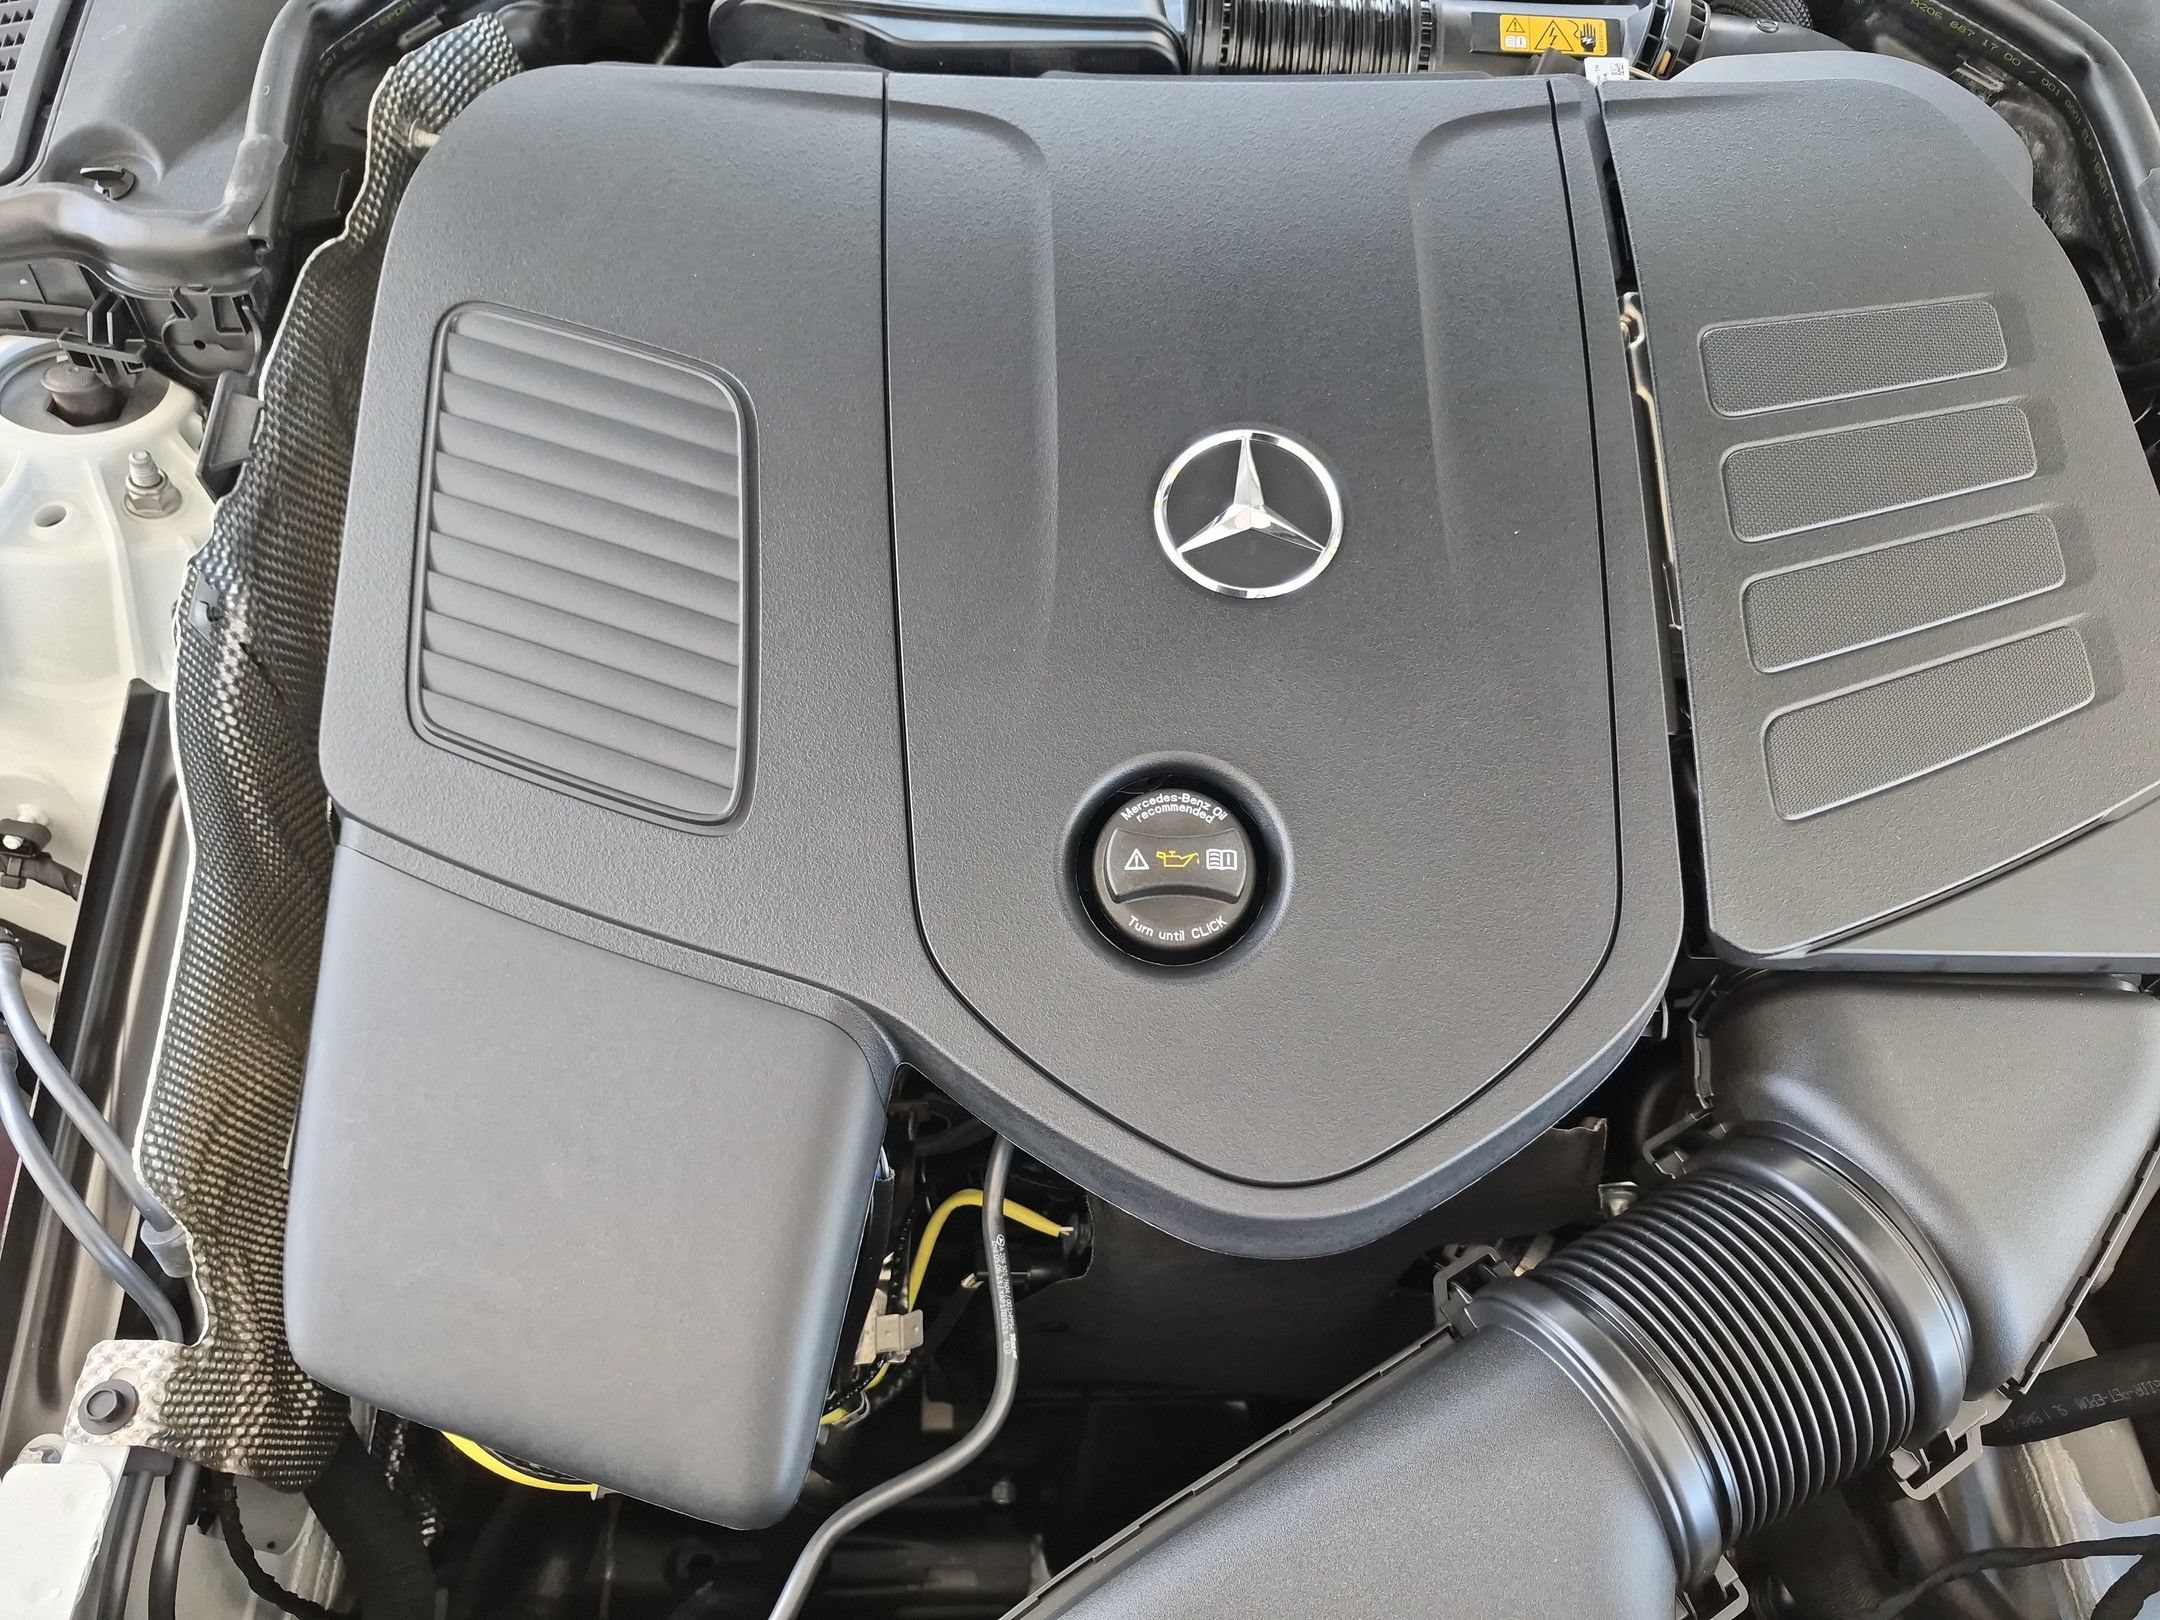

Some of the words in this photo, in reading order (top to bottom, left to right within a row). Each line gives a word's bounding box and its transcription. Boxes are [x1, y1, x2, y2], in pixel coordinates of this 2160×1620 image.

[1910, 0, 1943, 21] A206
[1950, 20, 1976, 38] 887
[1982, 39, 1999, 51] 17
[2003, 52, 2021, 67] 00
[2041, 77, 2061, 97] 001
[1120, 792, 1211, 822] Mercedes-Benz
[1212, 806, 1228, 822] Oil
[1136, 803, 1216, 825] recommended
[1128, 915, 1153, 937] Turn
[1158, 930, 1185, 942] until
[1191, 915, 1228, 940] CLICK
